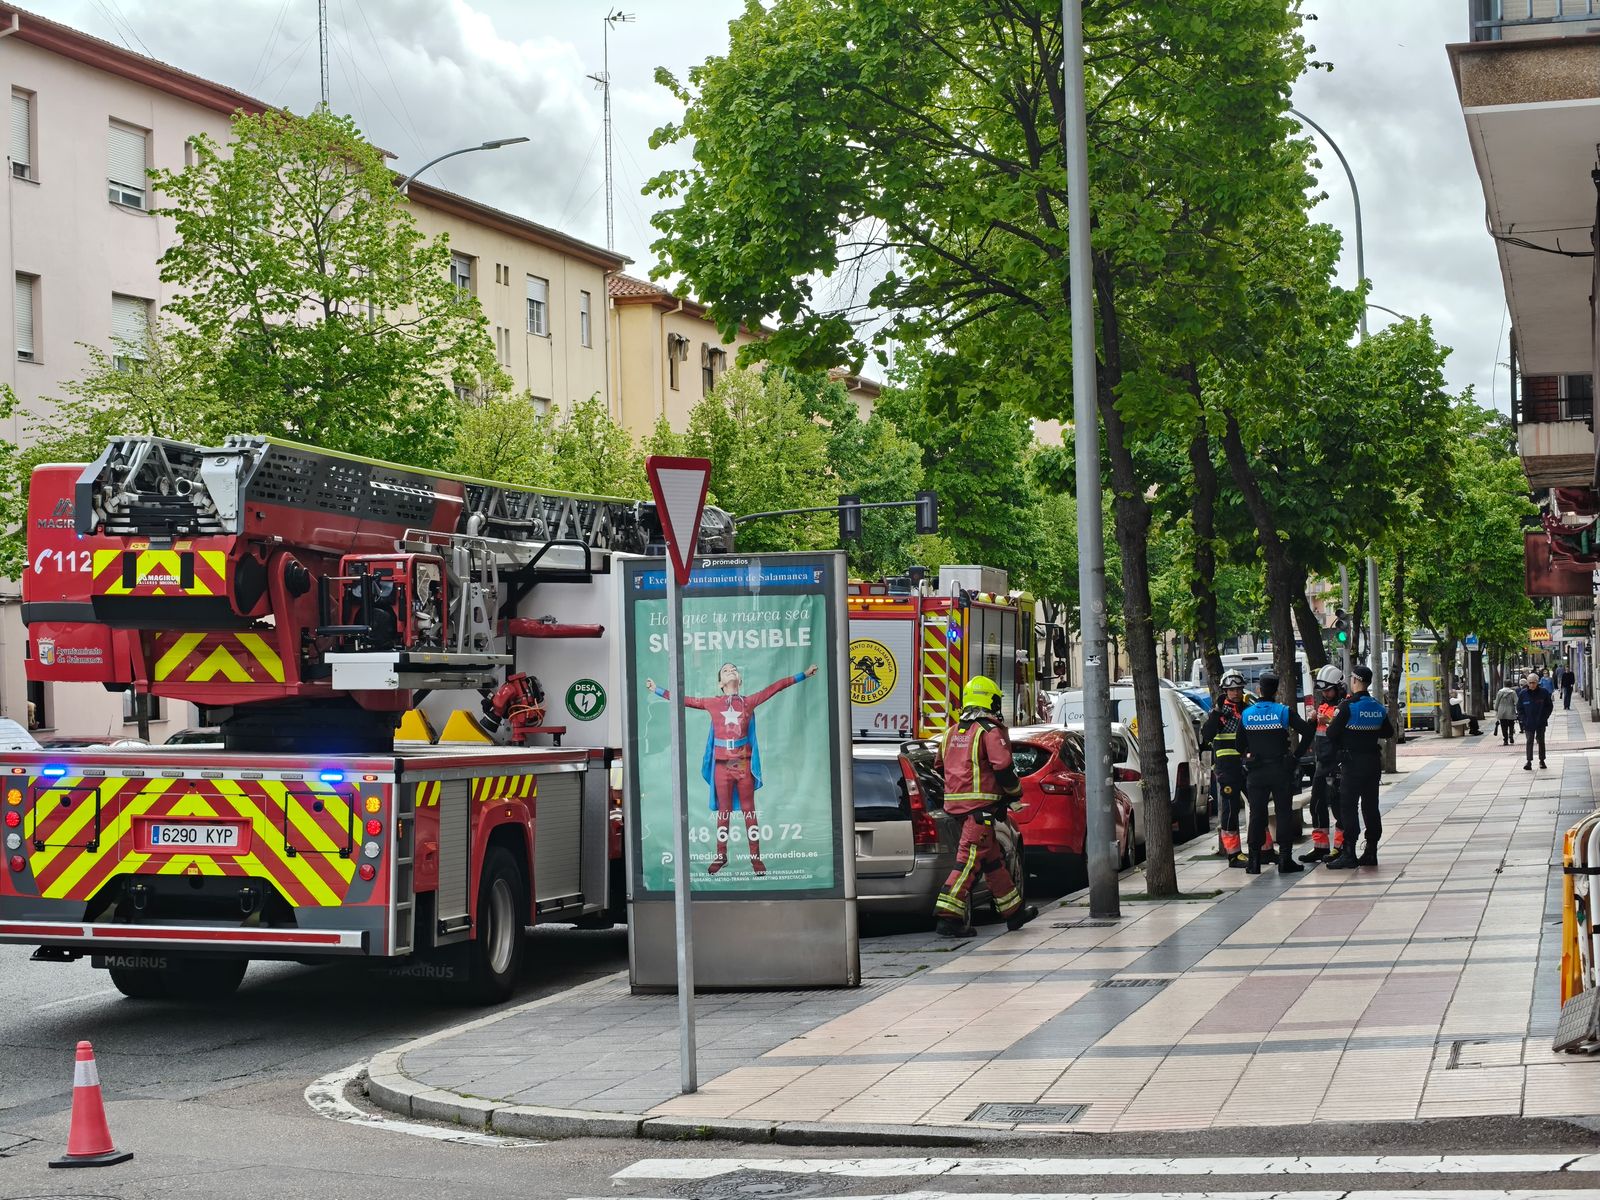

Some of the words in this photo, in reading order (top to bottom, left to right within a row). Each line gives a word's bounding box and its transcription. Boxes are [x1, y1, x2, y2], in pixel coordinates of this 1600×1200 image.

[37, 518, 75, 529] MAGIR
[53, 551, 92, 572] 112
[712, 558, 748, 566] promedios
[688, 574, 743, 585] yuntamiento
[746, 573, 758, 582] de
[759, 571, 808, 582] Salamanca
[649, 612, 668, 626] Ha
[682, 613, 707, 628] que
[712, 611, 727, 623] tu
[732, 610, 781, 623] marca
[784, 609, 809, 620] sea
[575, 684, 597, 692] DESA
[851, 685, 888, 702] MBEROS
[881, 714, 909, 729] 112
[1247, 712, 1279, 722] POLICÍA
[709, 810, 764, 821] ANÚNCIATE
[162, 826, 197, 843] 6290
[206, 827, 234, 844] KYP
[689, 826, 711, 843] 48
[716, 825, 741, 843] 66
[748, 825, 773, 841] 60
[779, 823, 803, 840] 72
[689, 852, 723, 860] medios
[736, 850, 818, 861] www.promedios.es
[104, 954, 168, 969] MAGIRUS
